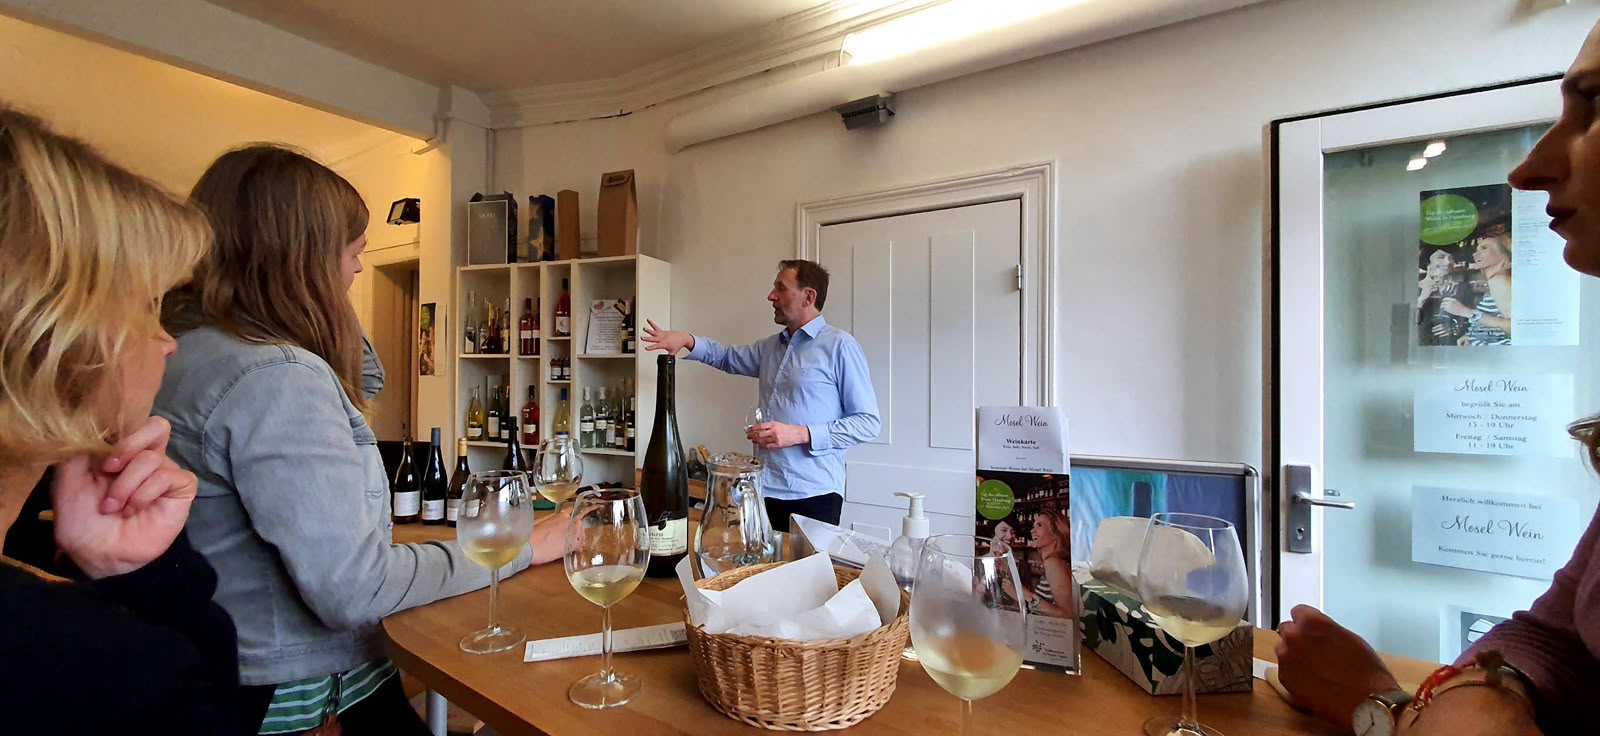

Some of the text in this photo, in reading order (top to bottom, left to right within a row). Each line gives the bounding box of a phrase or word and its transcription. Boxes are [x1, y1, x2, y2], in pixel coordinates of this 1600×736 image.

[1454, 379, 1528, 392] Mosel Wein
[995, 414, 1049, 427] Mosel Wein
[1491, 413, 1538, 422] Donnerstag
[1455, 433, 1482, 441] Freitag
[1493, 434, 1527, 442] Samstag
[1441, 495, 1542, 510] Herzlich willkommen bei
[1440, 515, 1545, 540] Mosel Wein
[1438, 545, 1546, 564] Kommen Sie gerne herein!
